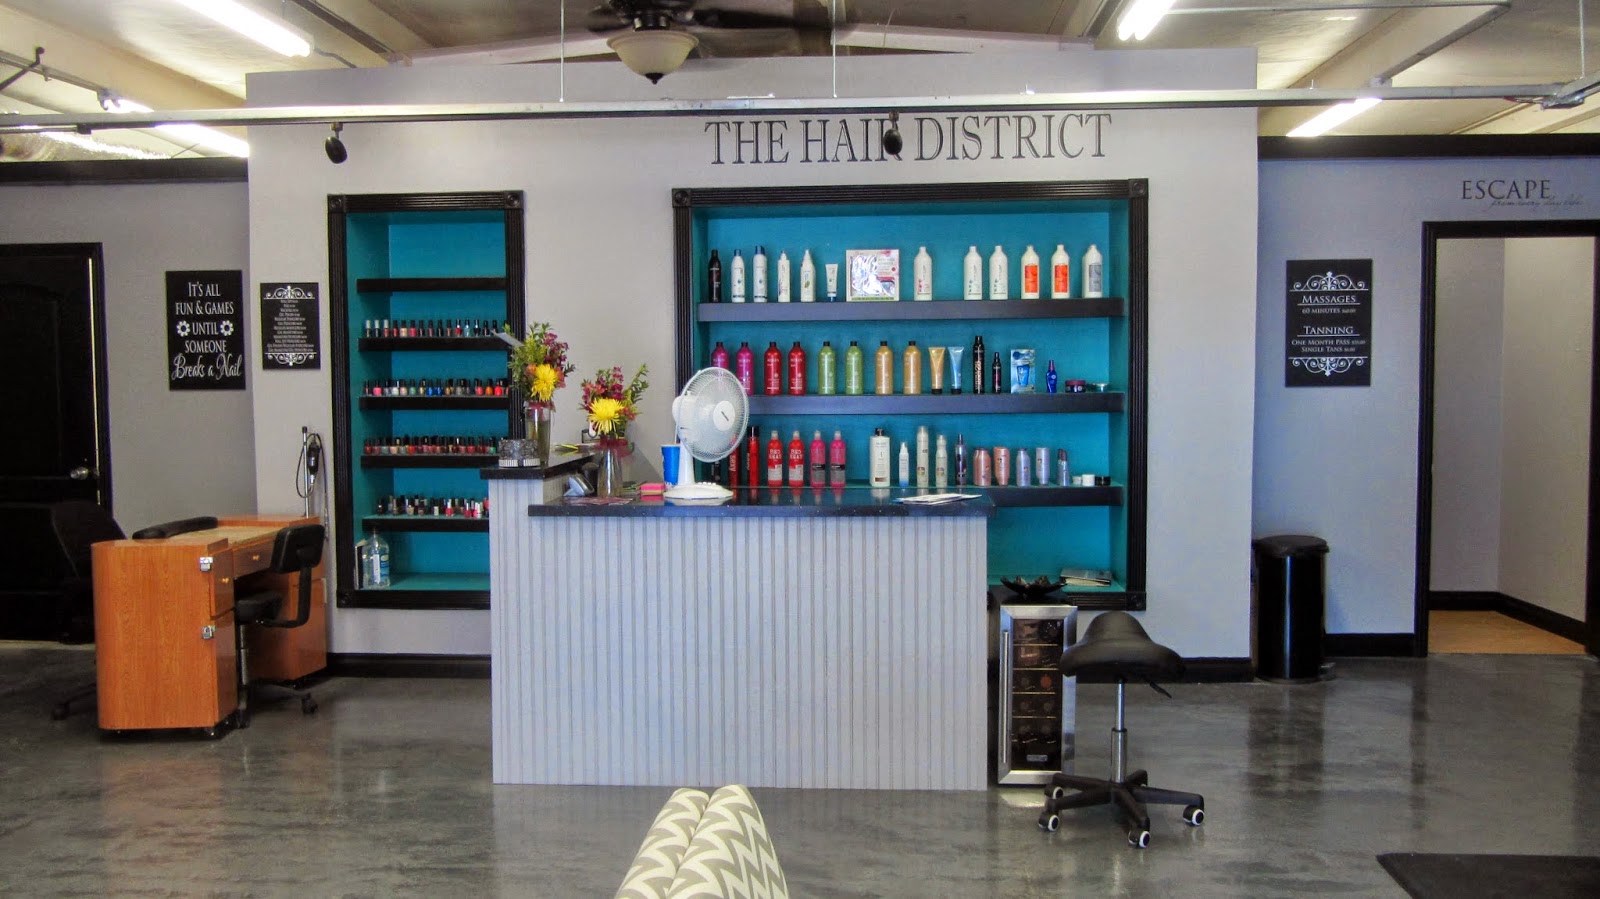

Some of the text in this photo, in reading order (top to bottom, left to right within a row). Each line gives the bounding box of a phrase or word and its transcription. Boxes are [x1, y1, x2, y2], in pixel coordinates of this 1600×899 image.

[704, 120, 789, 165] THE
[914, 113, 1112, 161] DISTRICT
[1462, 179, 1552, 200] ESCAPE
[205, 284, 220, 296] ALL
[176, 300, 234, 315] FUN & GAMES
[192, 322, 218, 335] UNTIL
[185, 340, 226, 353] SOMEONE
[172, 353, 242, 380] Breaks a Nail
